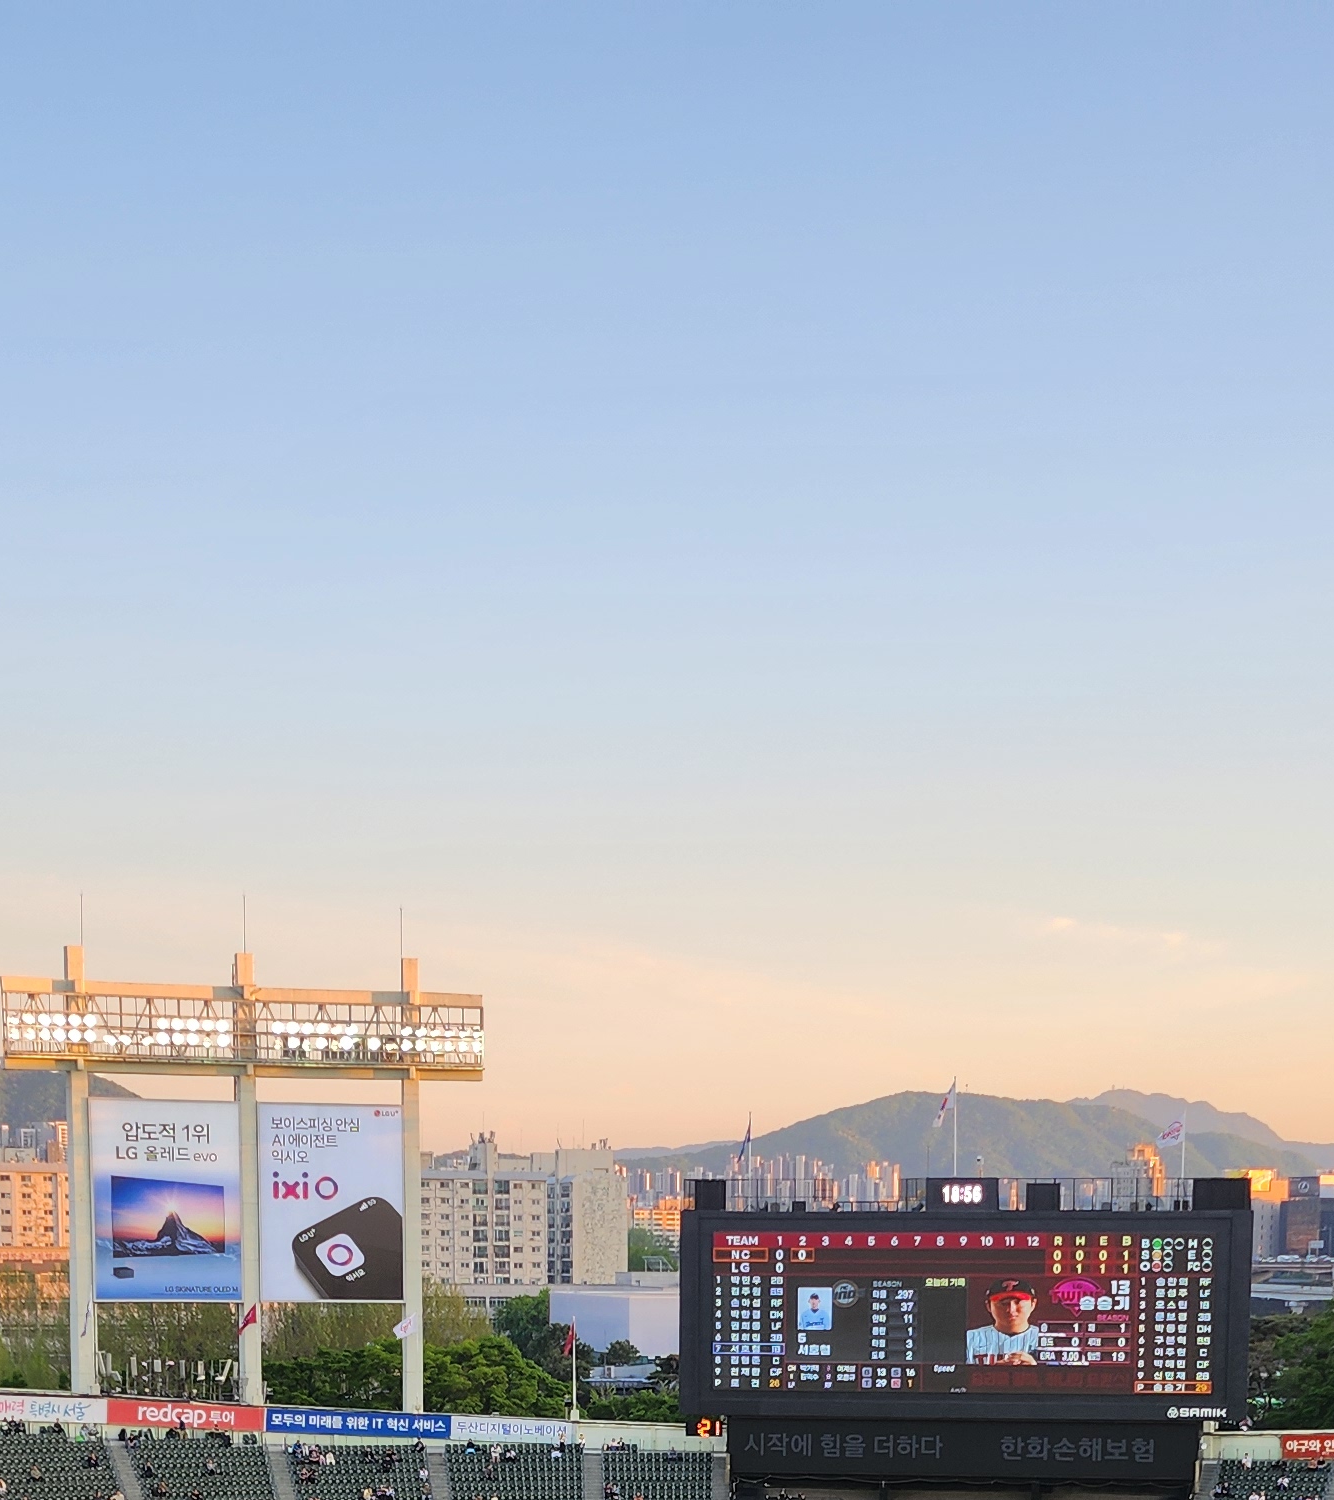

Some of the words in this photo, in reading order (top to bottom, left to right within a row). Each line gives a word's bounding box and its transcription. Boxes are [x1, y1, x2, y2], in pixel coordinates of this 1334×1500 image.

[270, 1116, 334, 1132] 보이스피싱
[336, 1117, 360, 1132] 안심
[121, 1122, 176, 1144] 압도적
[181, 1123, 211, 1144] 1위
[272, 1134, 286, 1147] AI
[288, 1134, 338, 1148] 에이전트
[116, 1146, 138, 1161] LG
[144, 1145, 190, 1162] 올레드
[193, 1150, 218, 1162] evo
[271, 1149, 310, 1164] 익시오
[942, 1183, 983, 1204] 18:56
[726, 1236, 758, 1246] TEAM
[777, 1236, 782, 1246] 1
[799, 1236, 806, 1246] 2
[822, 1236, 829, 1246] 3
[845, 1236, 853, 1246] 4
[868, 1236, 875, 1246] 5
[891, 1236, 898, 1246] 6
[914, 1236, 921, 1246] 7
[937, 1236, 944, 1246] 8
[960, 1236, 967, 1246] 9
[980, 1236, 993, 1246] 10
[1005, 1236, 1014, 1246] 11
[1027, 1236, 1039, 1246] 12
[1054, 1236, 1063, 1246] R
[1076, 1236, 1085, 1246] H
[1100, 1236, 1108, 1246] E
[1122, 1236, 1131, 1246] B
[731, 1250, 750, 1259] NC
[731, 1263, 750, 1273] LG
[1111, 1280, 1130, 1294] 13
[900, 1302, 914, 1312] 37
[904, 1314, 913, 1324] 11
[1112, 1352, 1125, 1362] 19
[137, 1404, 207, 1428] redcap
[209, 1411, 235, 1425] 투어
[1179, 1407, 1227, 1418] SAMIK
[270, 1413, 305, 1428] 모두의
[308, 1414, 343, 1430] 미래를
[347, 1416, 369, 1430] 위한
[372, 1418, 383, 1429] IT
[386, 1418, 409, 1432] 혁신
[412, 1419, 446, 1433] 서비스
[456, 1422, 567, 1438] 두산디지털이노베이션
[744, 1433, 812, 1456] 시작에
[821, 1433, 866, 1458] 힘을
[873, 1435, 944, 1460] 더하다
[1000, 1435, 1157, 1464] 한화손해보험
[1286, 1439, 1322, 1452] 야구와
